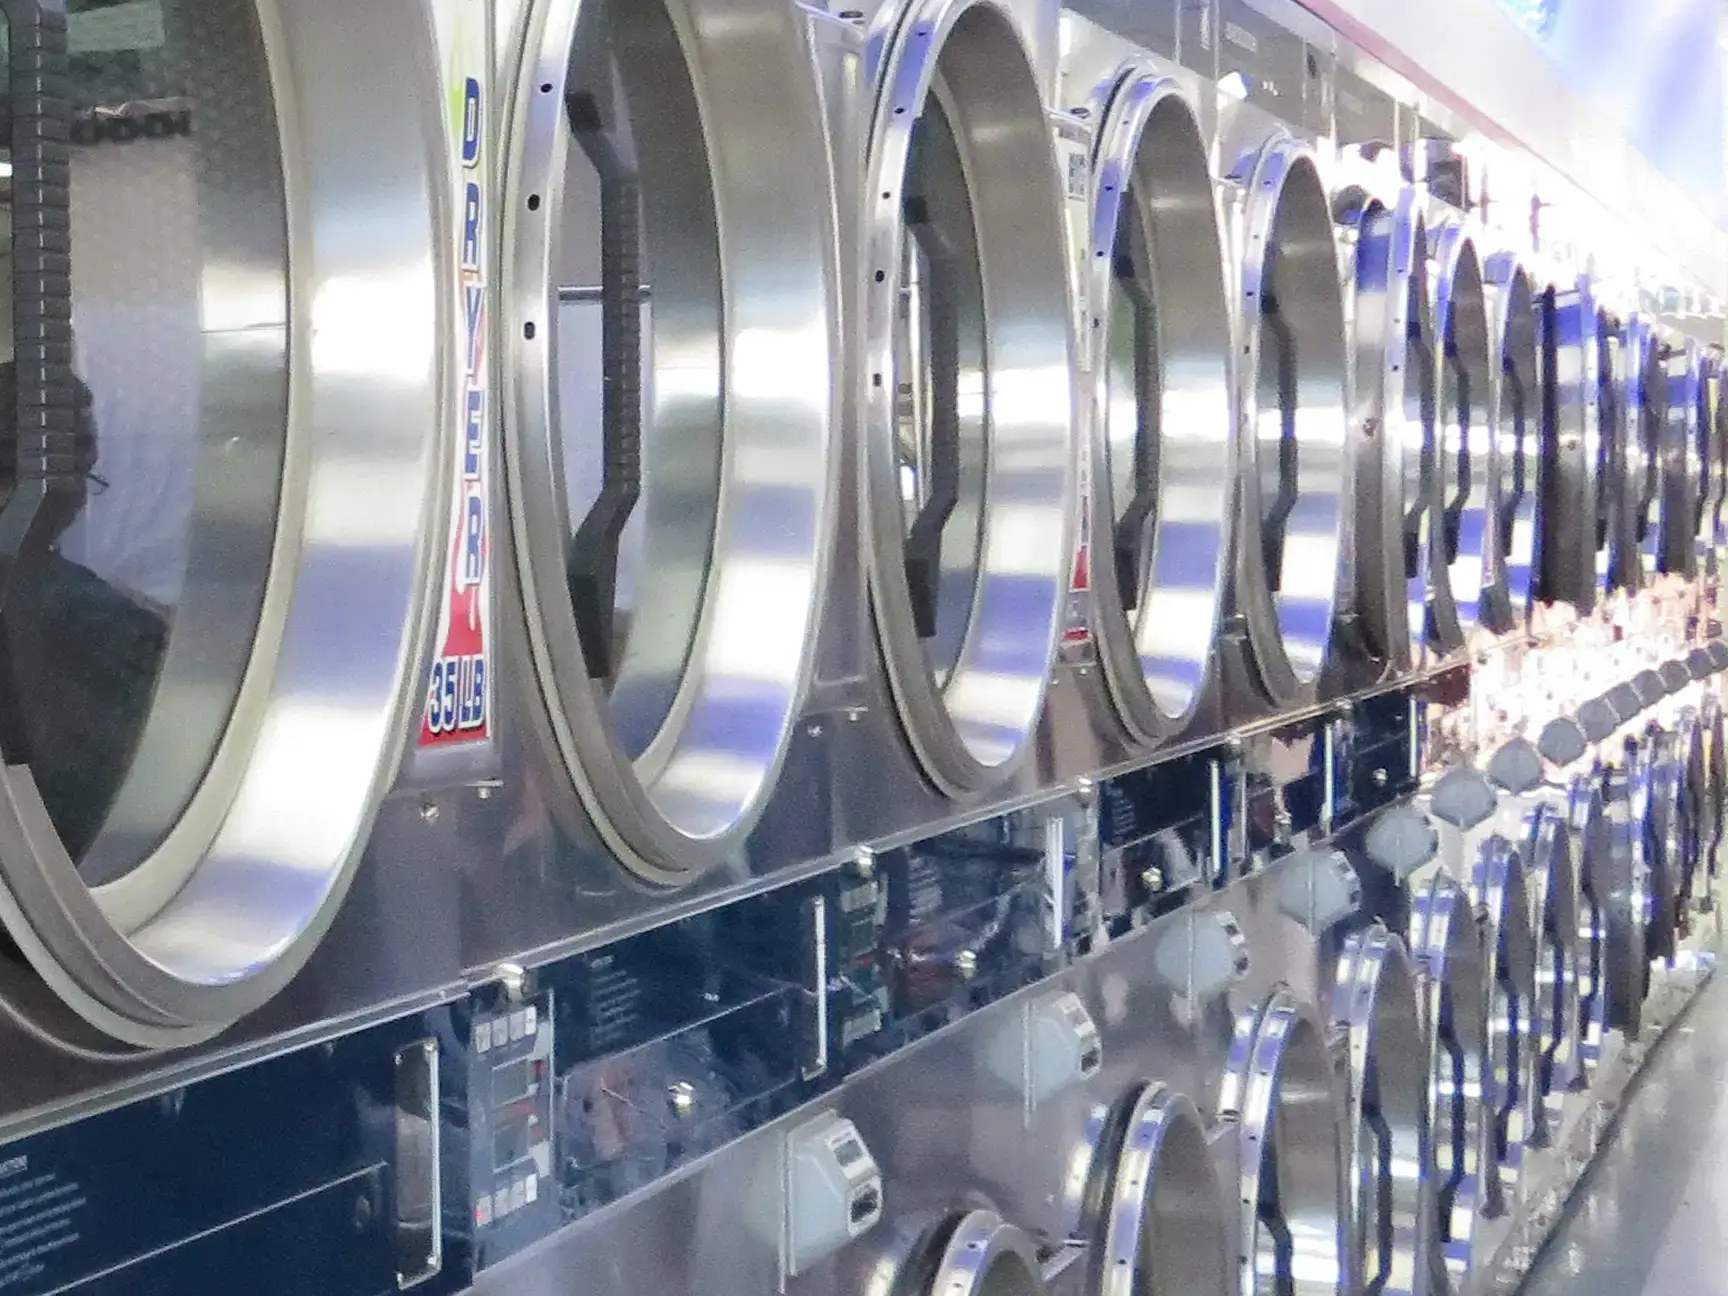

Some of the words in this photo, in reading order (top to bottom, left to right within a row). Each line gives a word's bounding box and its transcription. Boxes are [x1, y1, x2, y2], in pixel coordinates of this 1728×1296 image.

[460, 76, 486, 585] DRYER
[429, 657, 457, 734] 35
[457, 653, 485, 728] LB
